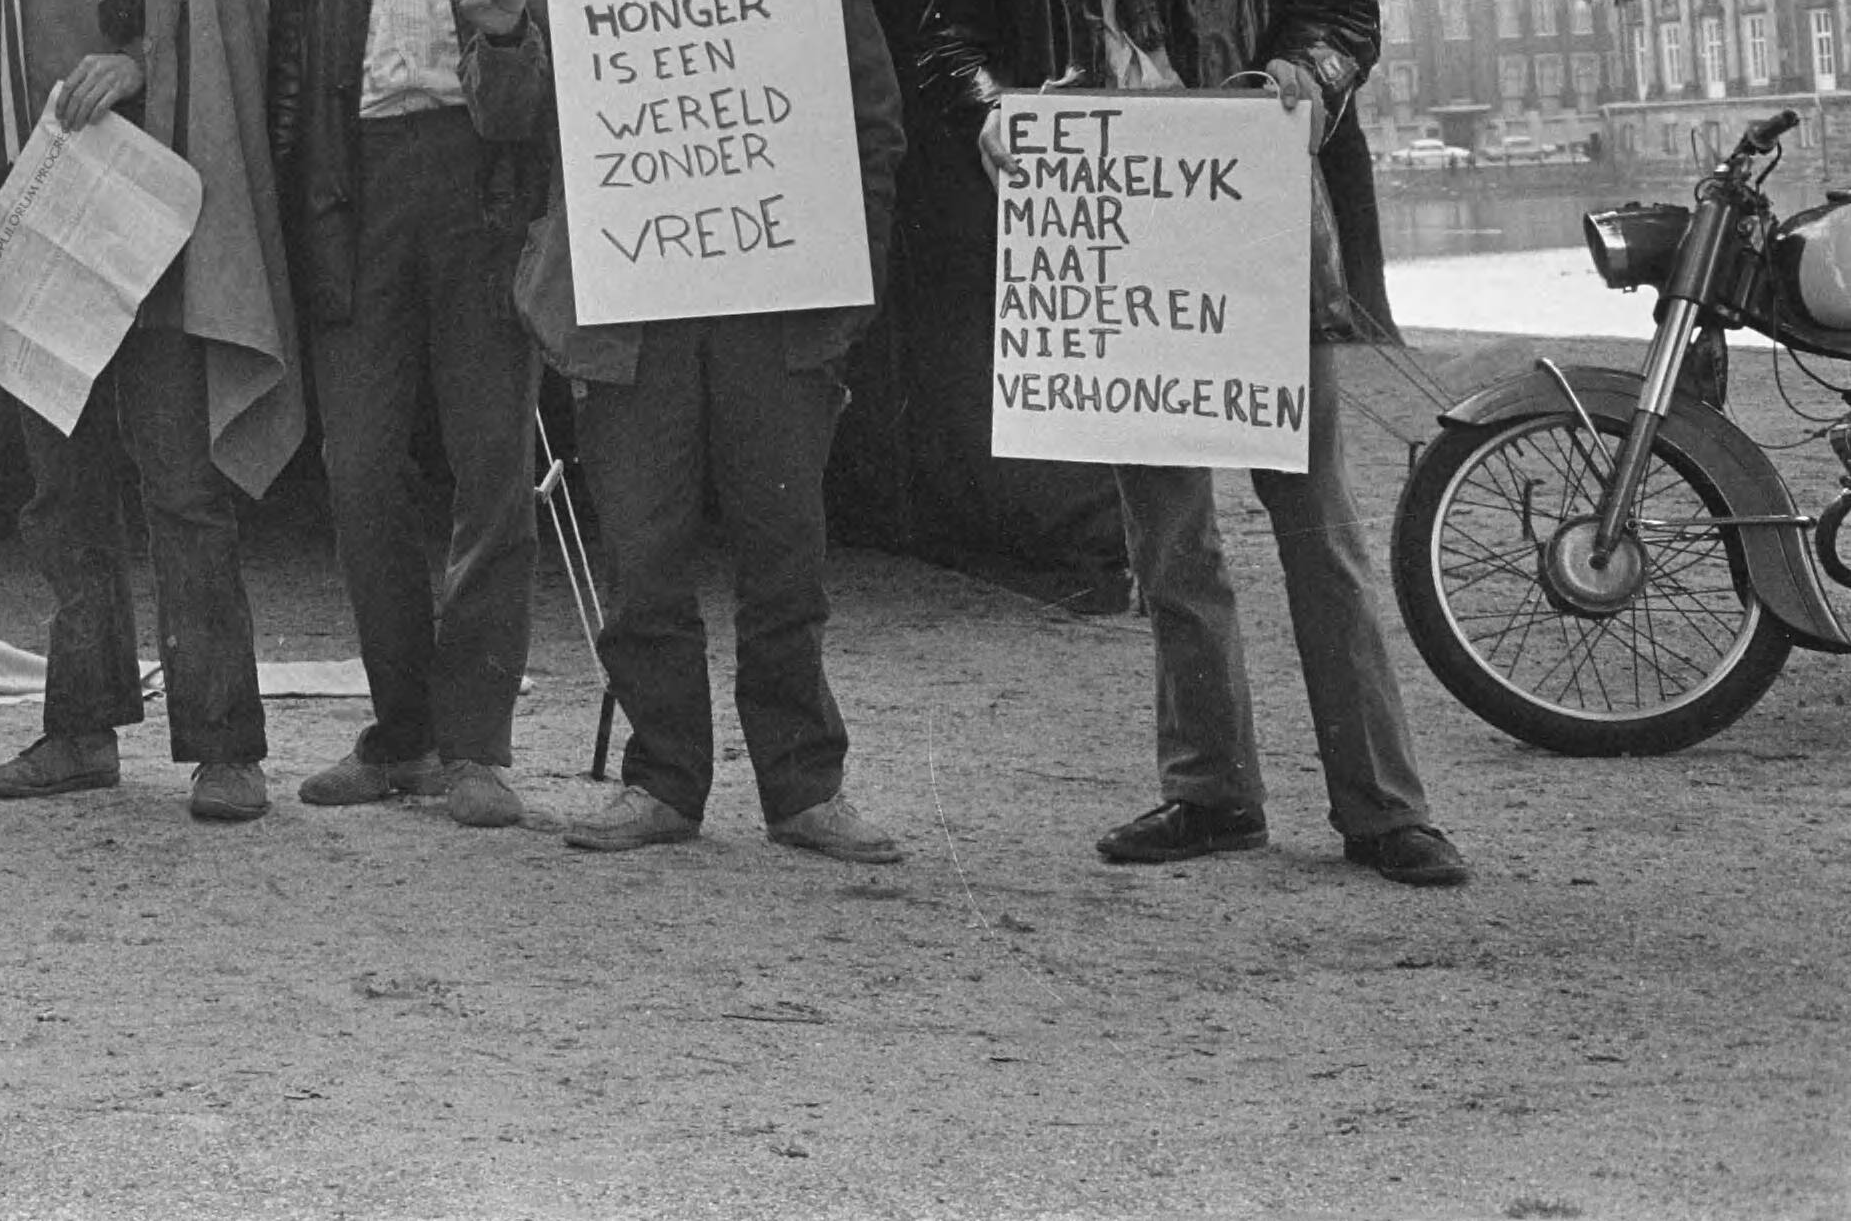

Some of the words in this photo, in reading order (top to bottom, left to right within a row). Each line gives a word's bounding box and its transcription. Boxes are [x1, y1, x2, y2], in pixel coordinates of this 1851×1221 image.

[592, 51, 638, 84] IS
[652, 38, 737, 80] EEN
[596, 84, 793, 139] WERELD
[1008, 109, 1124, 157] EET
[594, 132, 776, 187] ZONDER
[1008, 155, 1243, 201] SMAKELYK
[600, 193, 797, 263] VREDE
[1003, 195, 1130, 244] MAAR
[1002, 245, 1124, 283] LAAT
[999, 283, 1227, 334] ANDEREN
[1000, 327, 1123, 359] NIET
[997, 373, 1306, 432] VERHONGEREN
